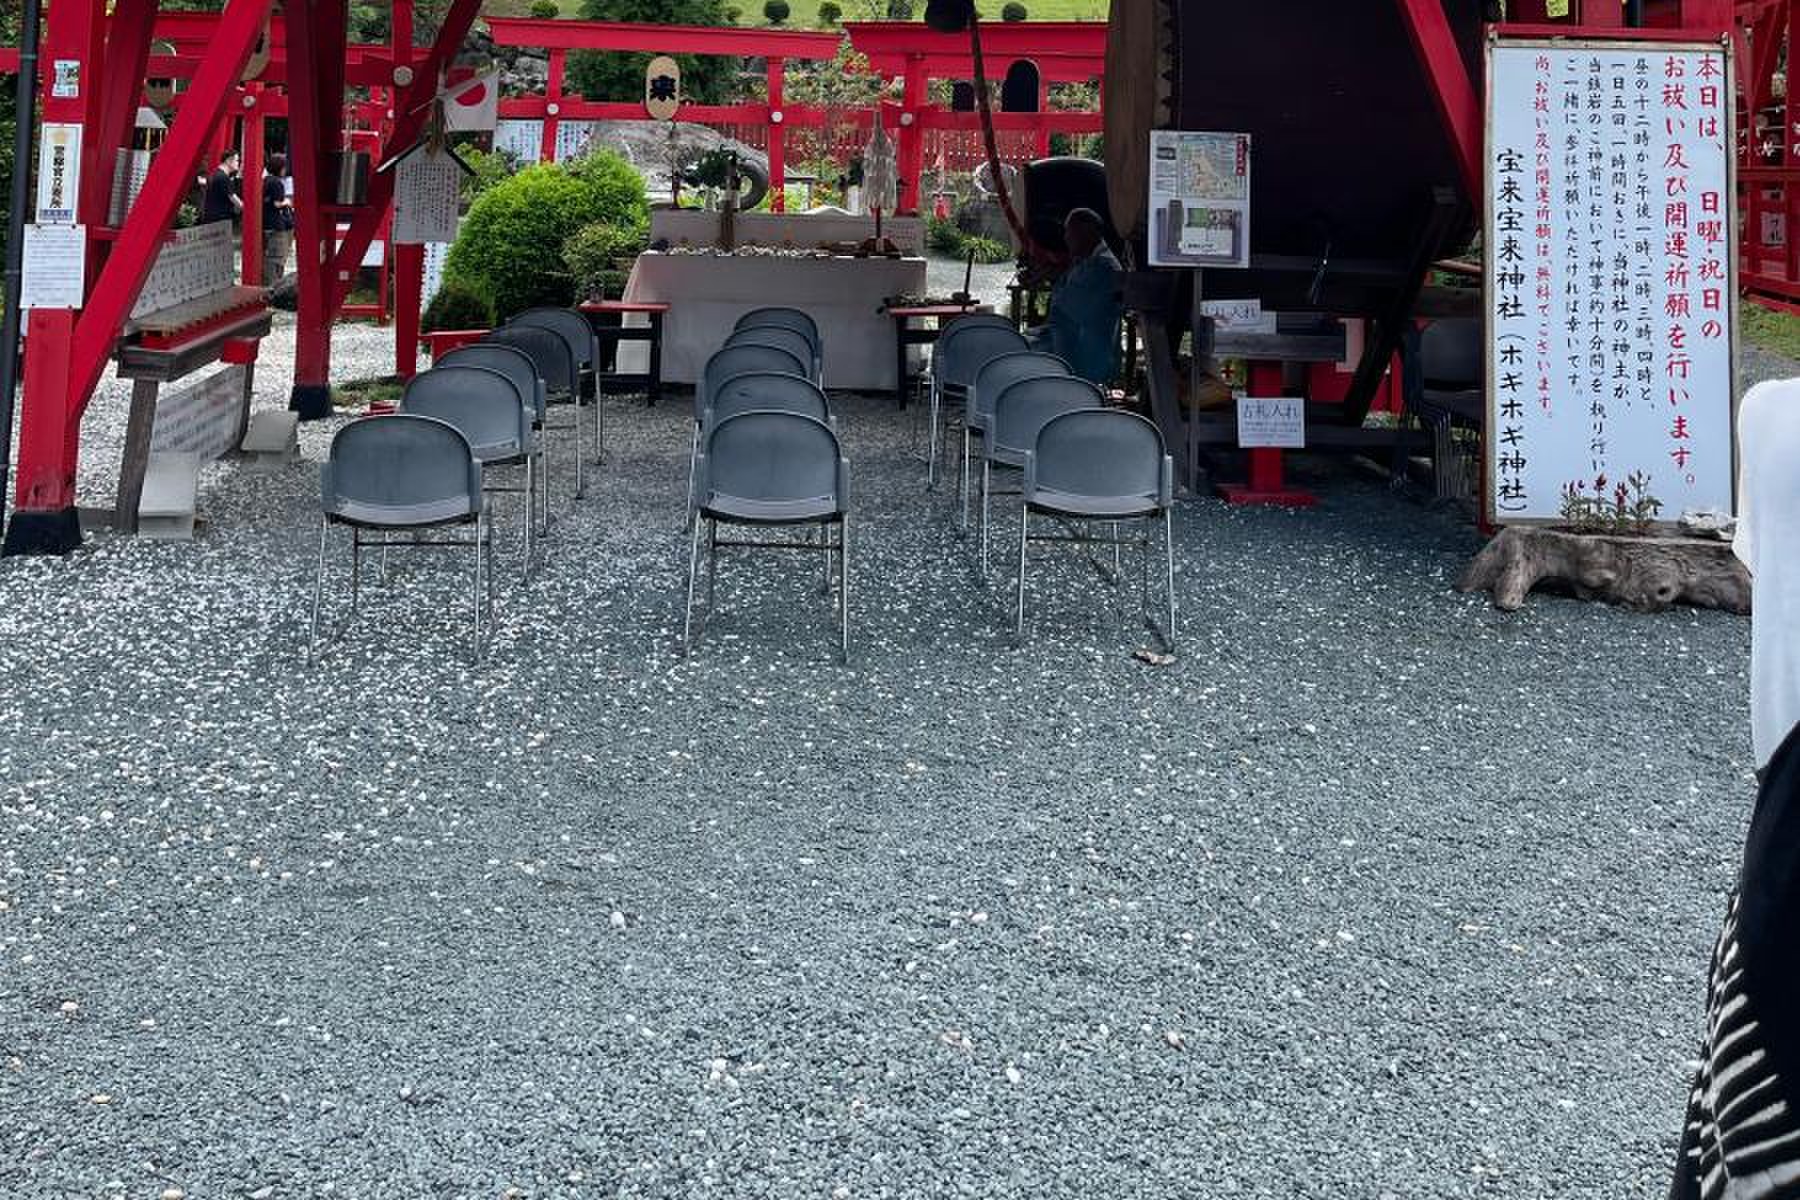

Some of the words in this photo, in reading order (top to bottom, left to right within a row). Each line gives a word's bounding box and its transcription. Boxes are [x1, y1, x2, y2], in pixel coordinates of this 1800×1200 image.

[1695, 54, 1723, 152] 本日は、
[1496, 148, 1527, 512] 宝来宝来神社（ホギホギ神社）
[1662, 55, 1696, 485] お祓い及び開運祈願を行います。
[1696, 191, 1727, 338] 日曜・祝日の
